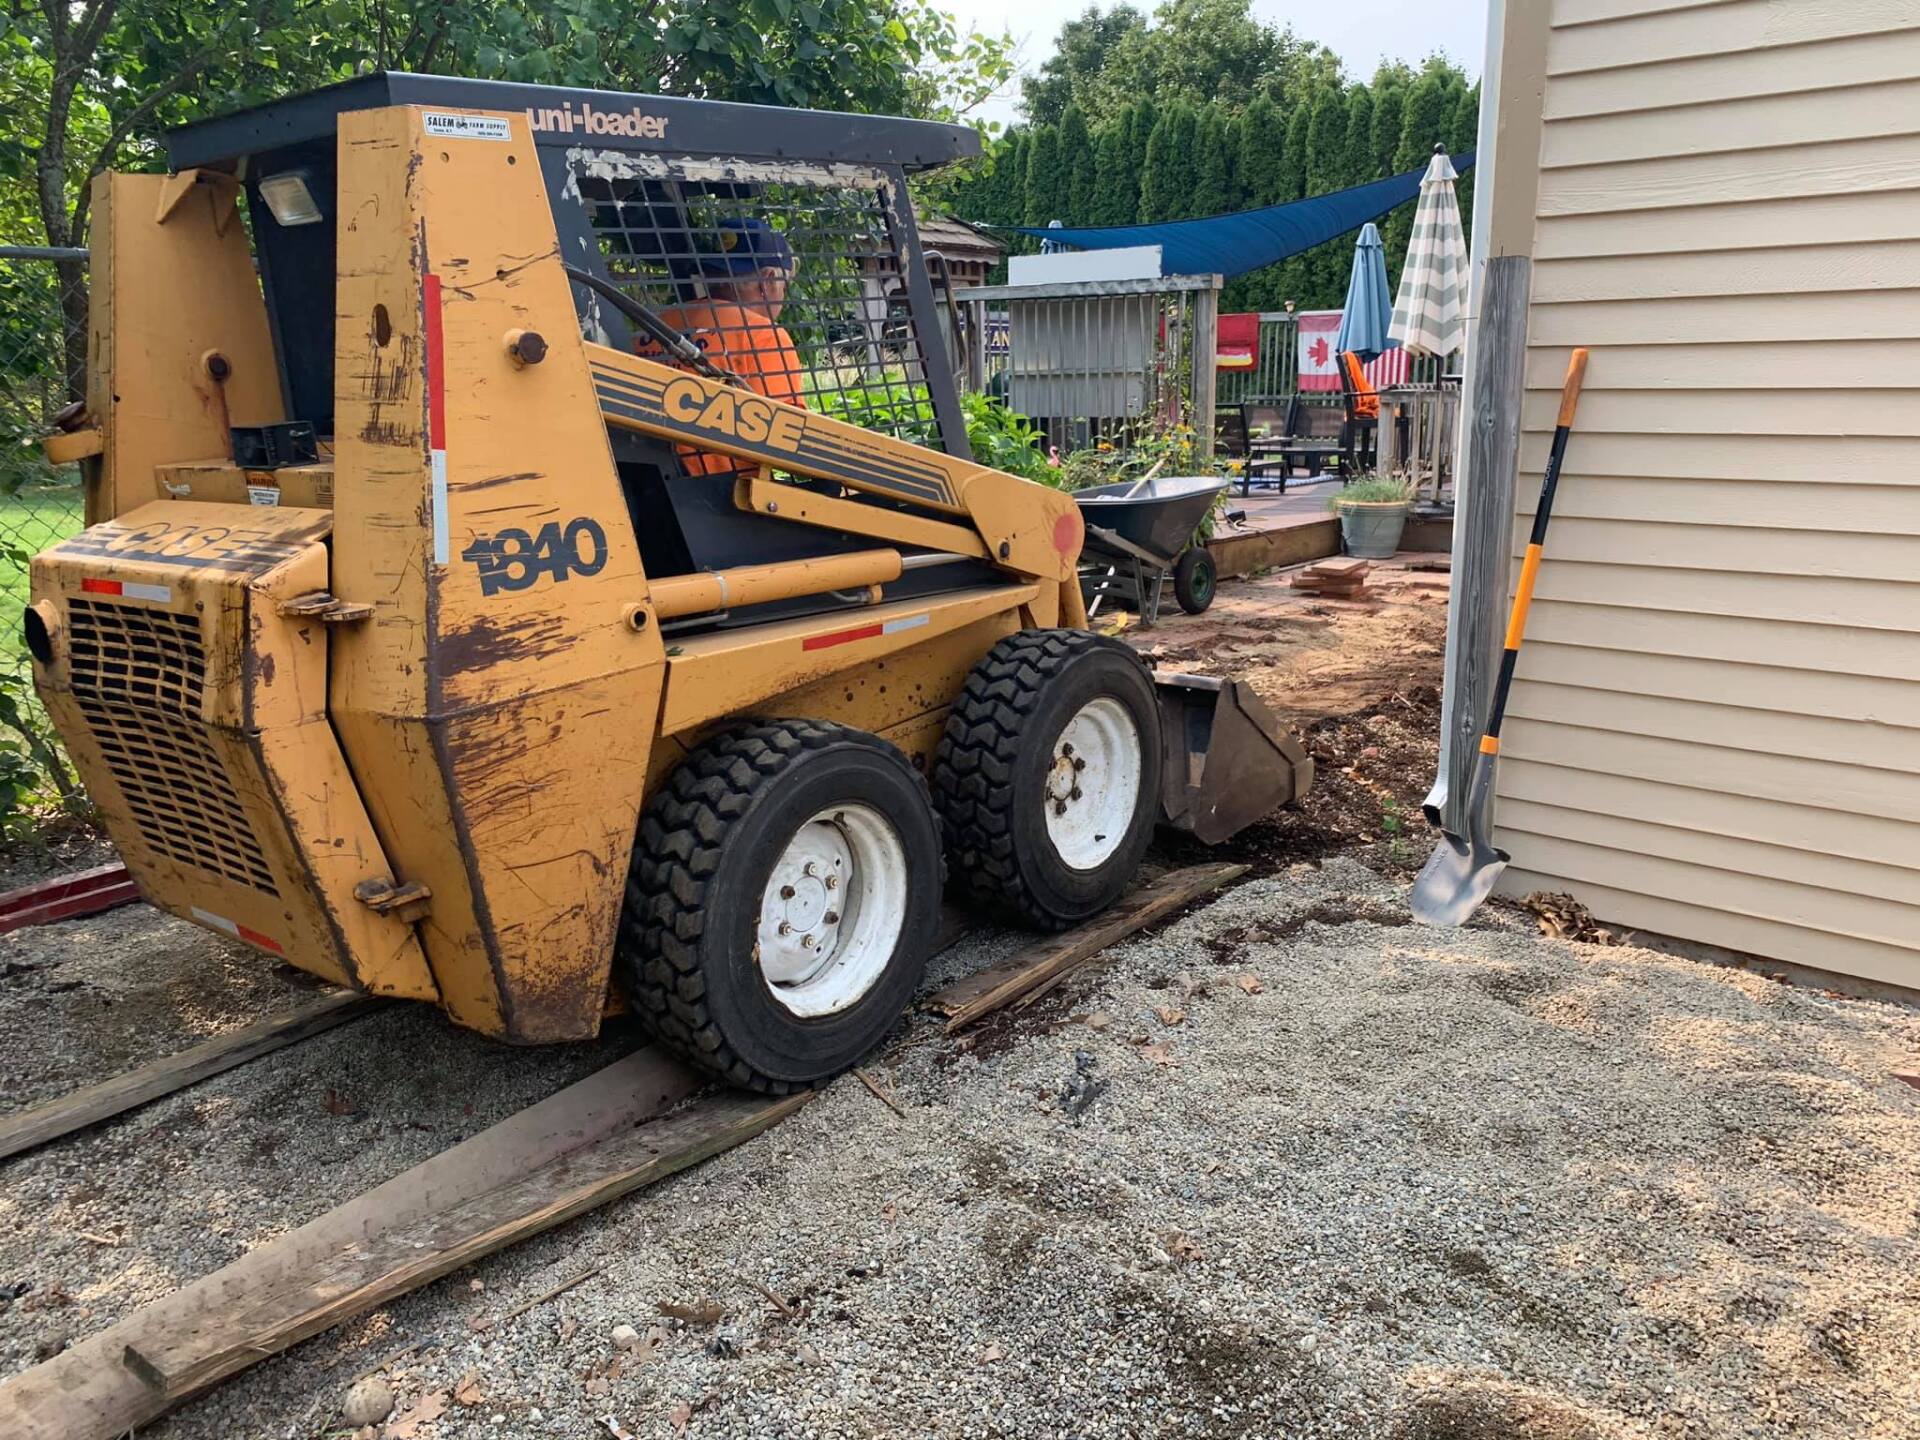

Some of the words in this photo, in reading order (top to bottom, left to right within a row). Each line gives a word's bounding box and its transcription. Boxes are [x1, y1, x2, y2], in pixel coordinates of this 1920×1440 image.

[427, 116, 455, 128] SALEM
[526, 102, 668, 139] uni-loader
[661, 376, 807, 453] CASE
[105, 522, 272, 559] CASE
[461, 517, 608, 597] 1840
